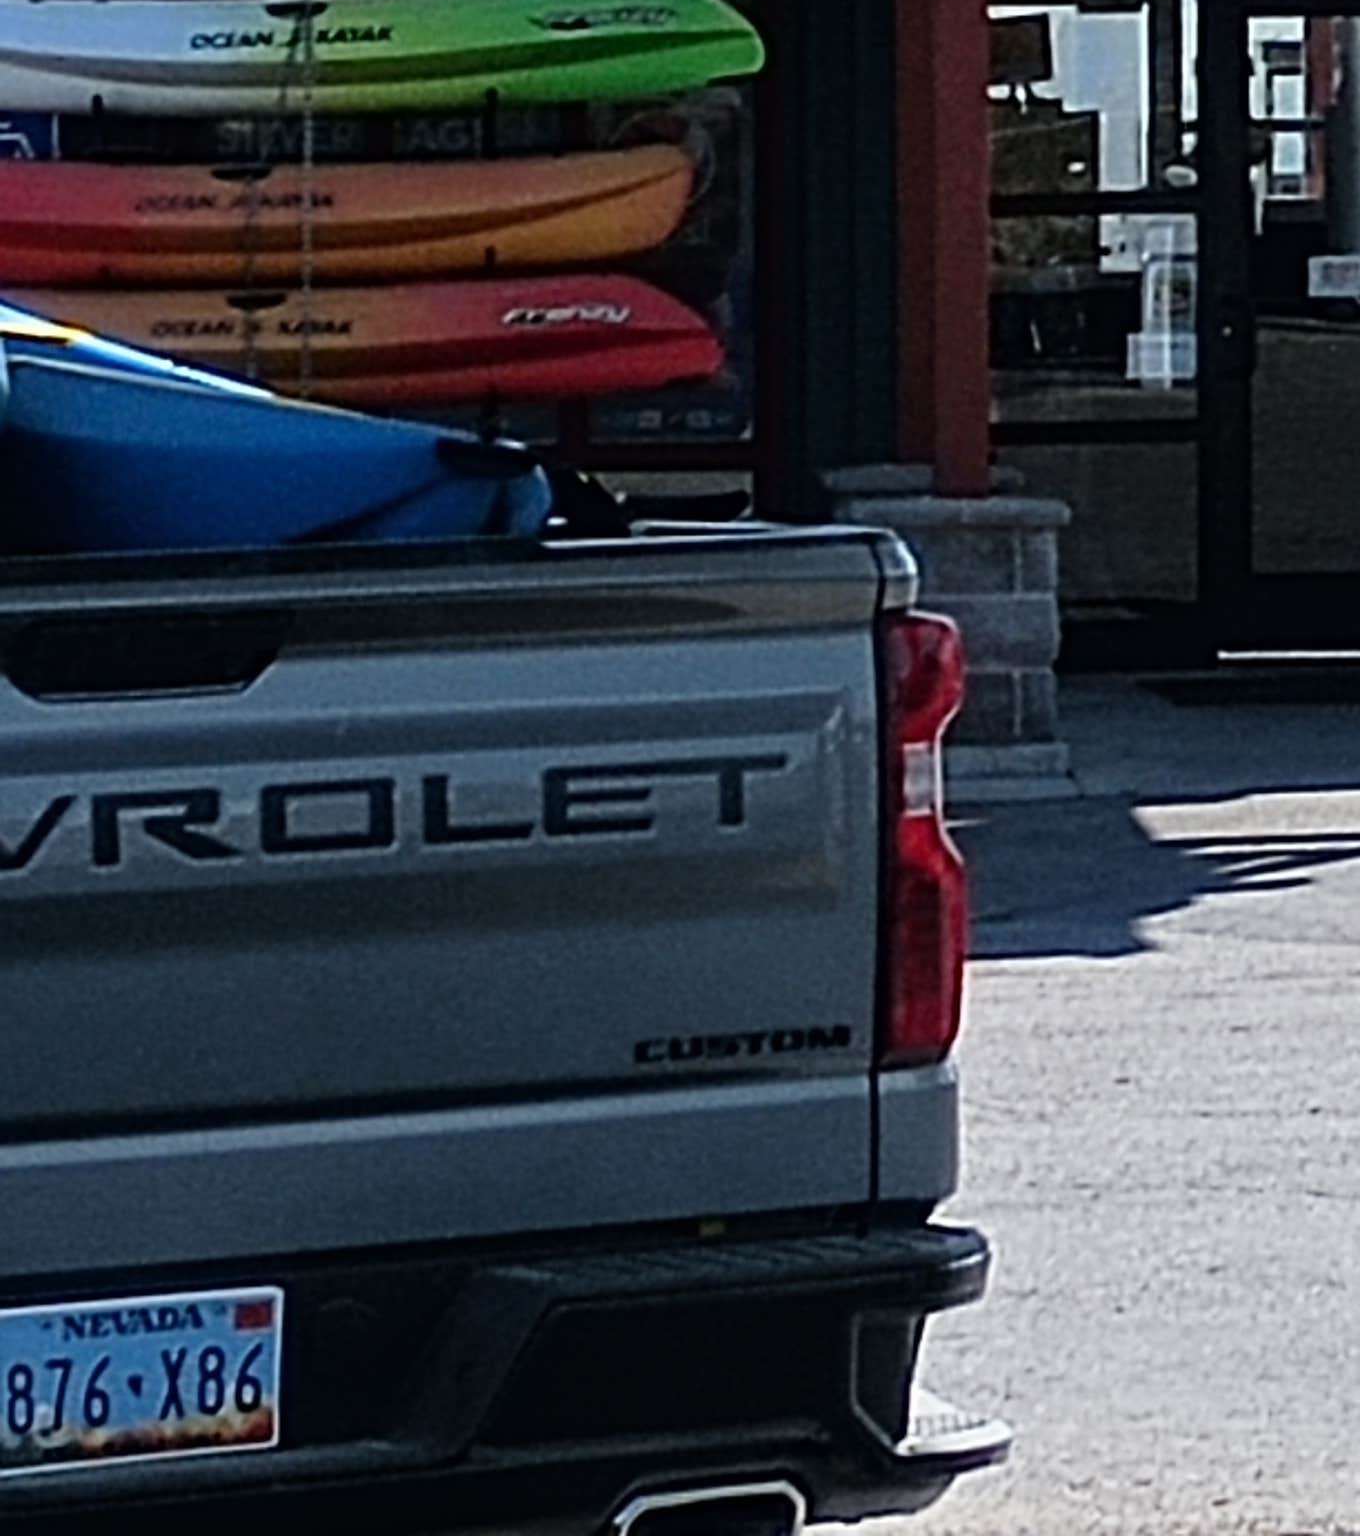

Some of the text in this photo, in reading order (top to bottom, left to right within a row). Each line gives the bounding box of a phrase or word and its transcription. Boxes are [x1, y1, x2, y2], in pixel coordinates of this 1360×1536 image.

[190, 31, 274, 50] OCEAN
[634, 1024, 851, 1064] CUSTOM
[61, 1304, 204, 1342] NEVADA
